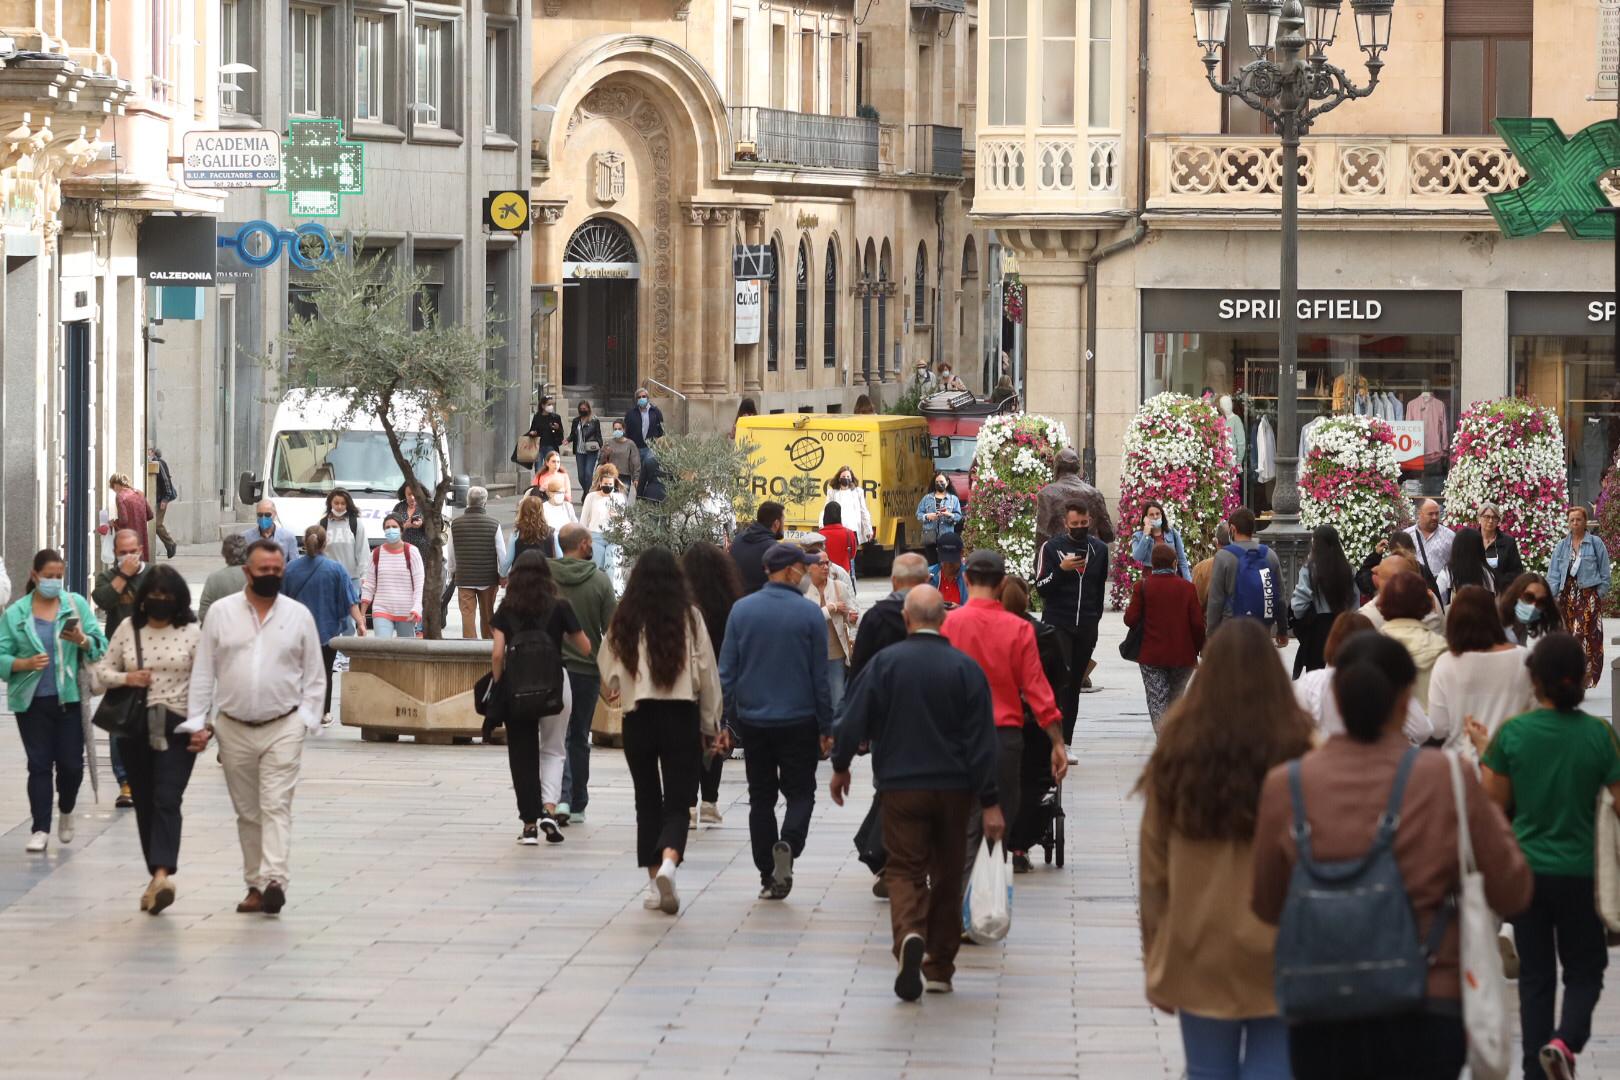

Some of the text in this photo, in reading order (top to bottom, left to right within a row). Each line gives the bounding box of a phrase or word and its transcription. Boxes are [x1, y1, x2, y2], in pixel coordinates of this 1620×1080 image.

[195, 137, 270, 151] ACADEMIA
[202, 154, 262, 168] GALILEO
[149, 271, 212, 280] CALZEDONIA
[1218, 298, 1382, 320] SPRIGFIELD
[820, 431, 863, 443] 00 0002
[736, 475, 877, 499] PROSER
[1263, 571, 1273, 615] adidas
